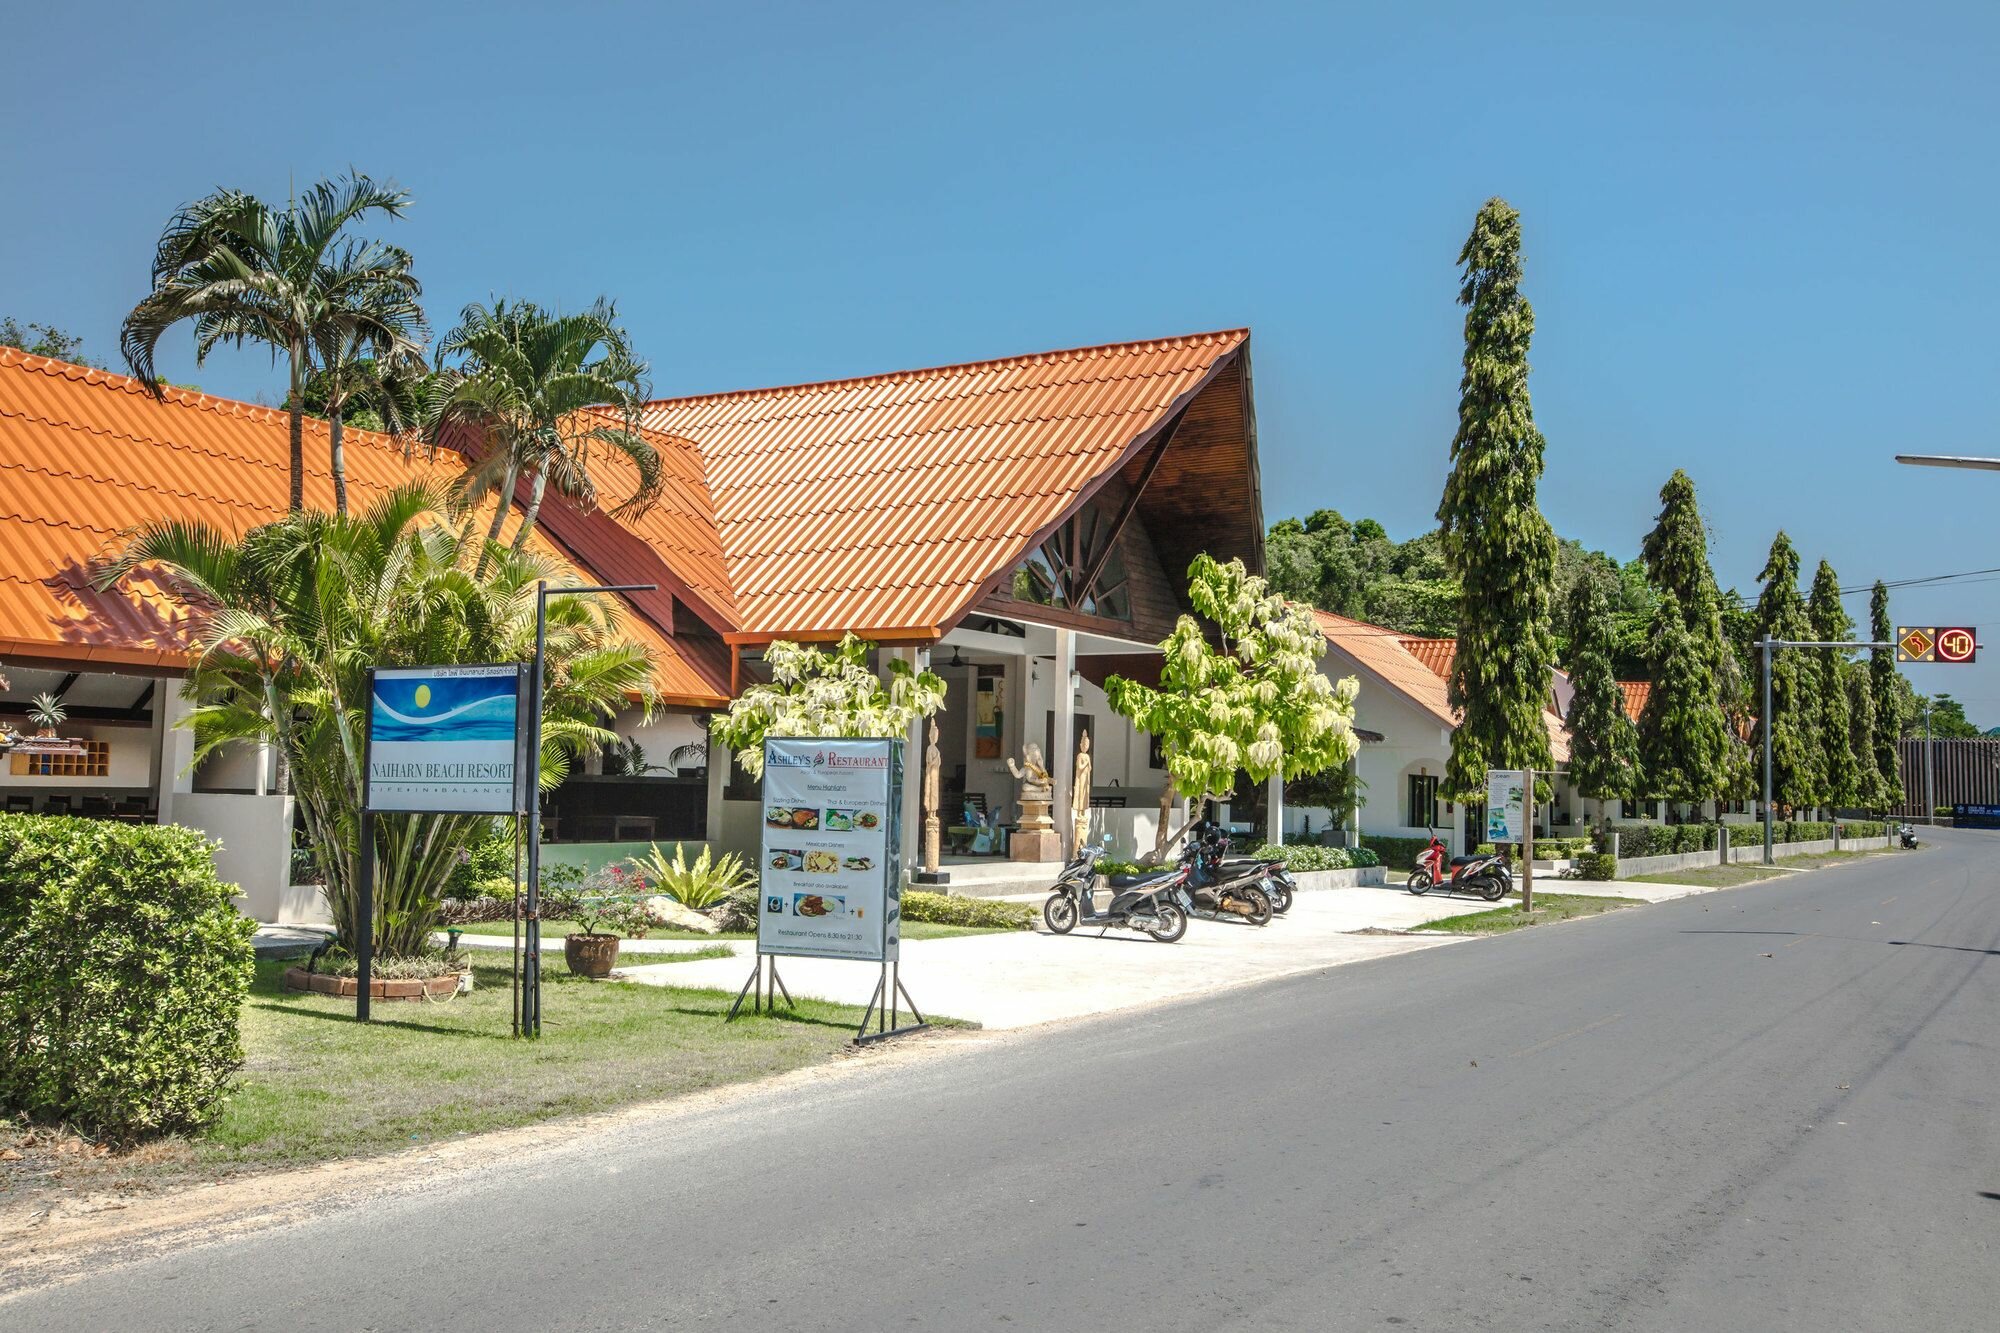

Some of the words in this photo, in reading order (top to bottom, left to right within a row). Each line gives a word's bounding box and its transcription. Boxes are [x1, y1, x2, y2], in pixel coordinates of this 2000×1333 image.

[1944, 636, 1969, 654] 40
[767, 750, 811, 765] ASHLEY'S
[828, 751, 889, 767] RESTAURANT
[372, 763, 422, 778] NAIHARN
[426, 763, 463, 778] BEACH
[468, 764, 513, 779] RESORT
[778, 929, 808, 937] Restaurant
[808, 930, 826, 939] Opens
[840, 931, 846, 939] to
